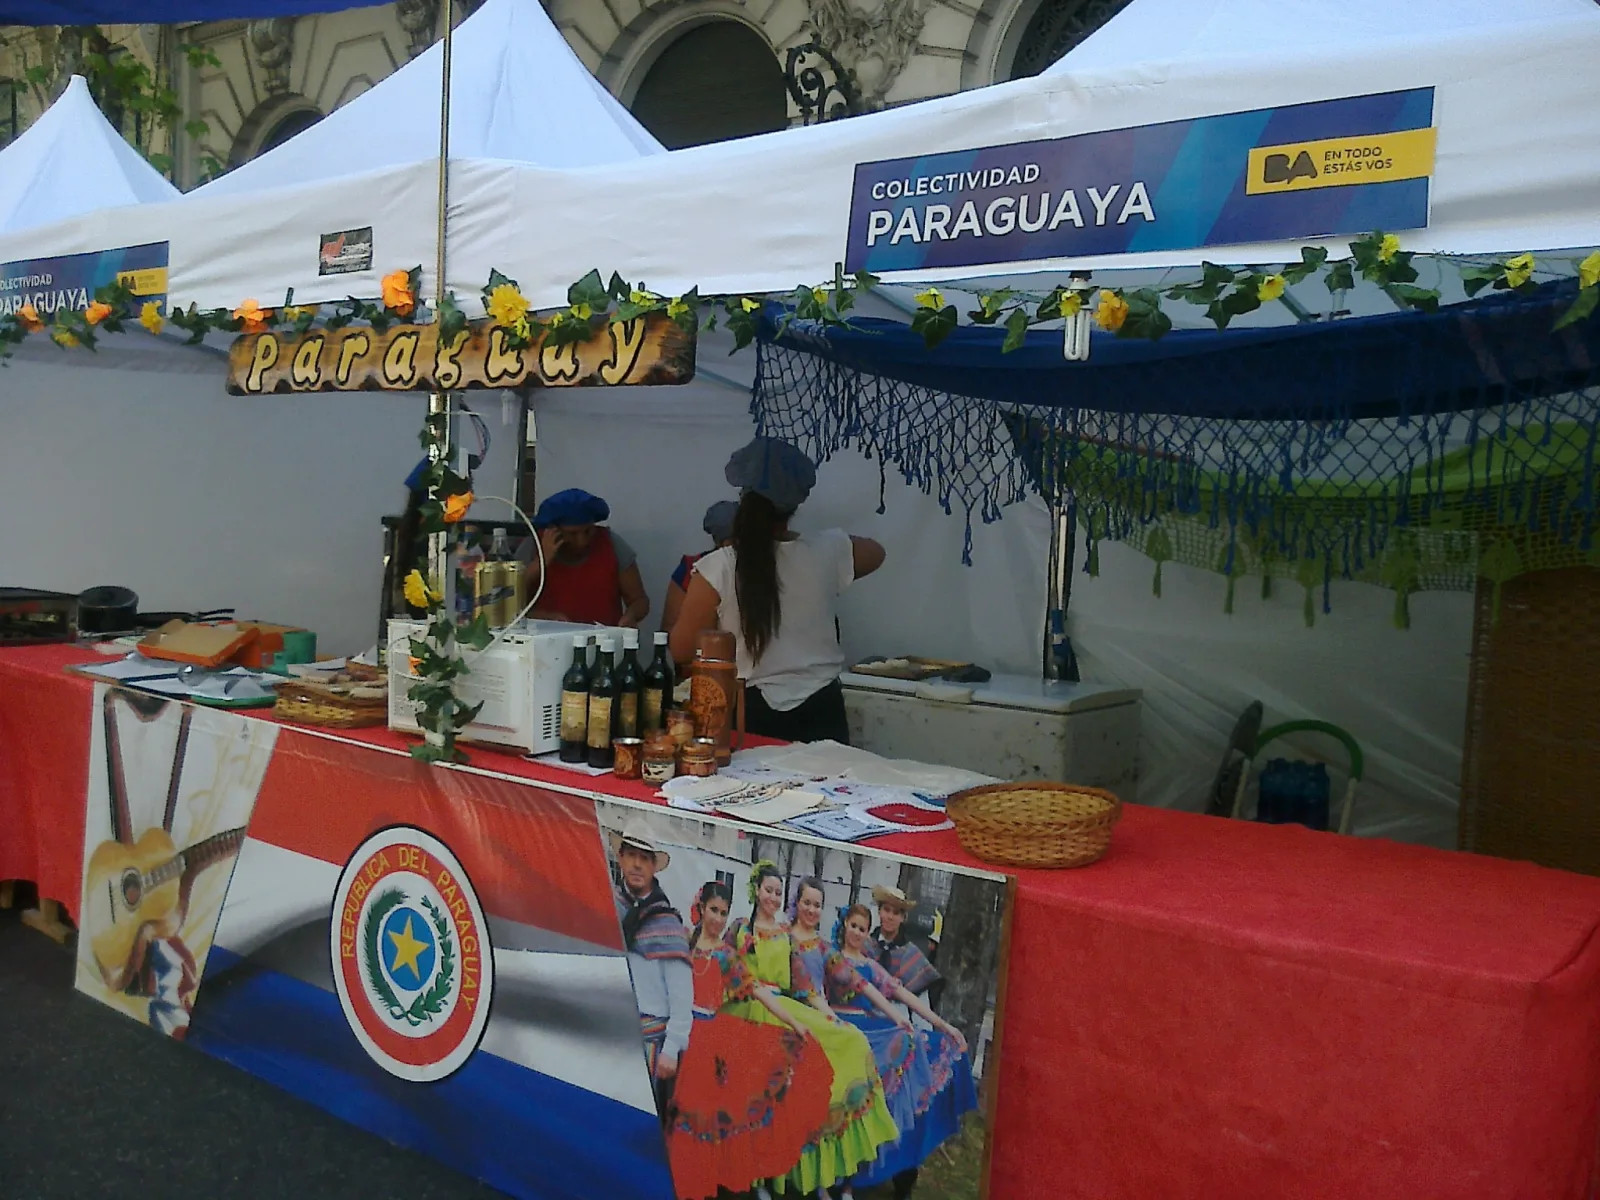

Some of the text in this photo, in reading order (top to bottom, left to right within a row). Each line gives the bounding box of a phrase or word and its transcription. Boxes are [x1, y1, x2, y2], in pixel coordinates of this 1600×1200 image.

[1264, 151, 1318, 185] BA
[1323, 158, 1393, 175] ESTÁS VOS
[1325, 146, 1382, 161] EN TODO
[871, 163, 1040, 200] COLECTIVIDAD
[866, 181, 1156, 247] PARAGUAYA
[0, 273, 53, 291] OLECTIVIDAD
[341, 847, 480, 1011] REPUBLICA DEL PARAGUAY
